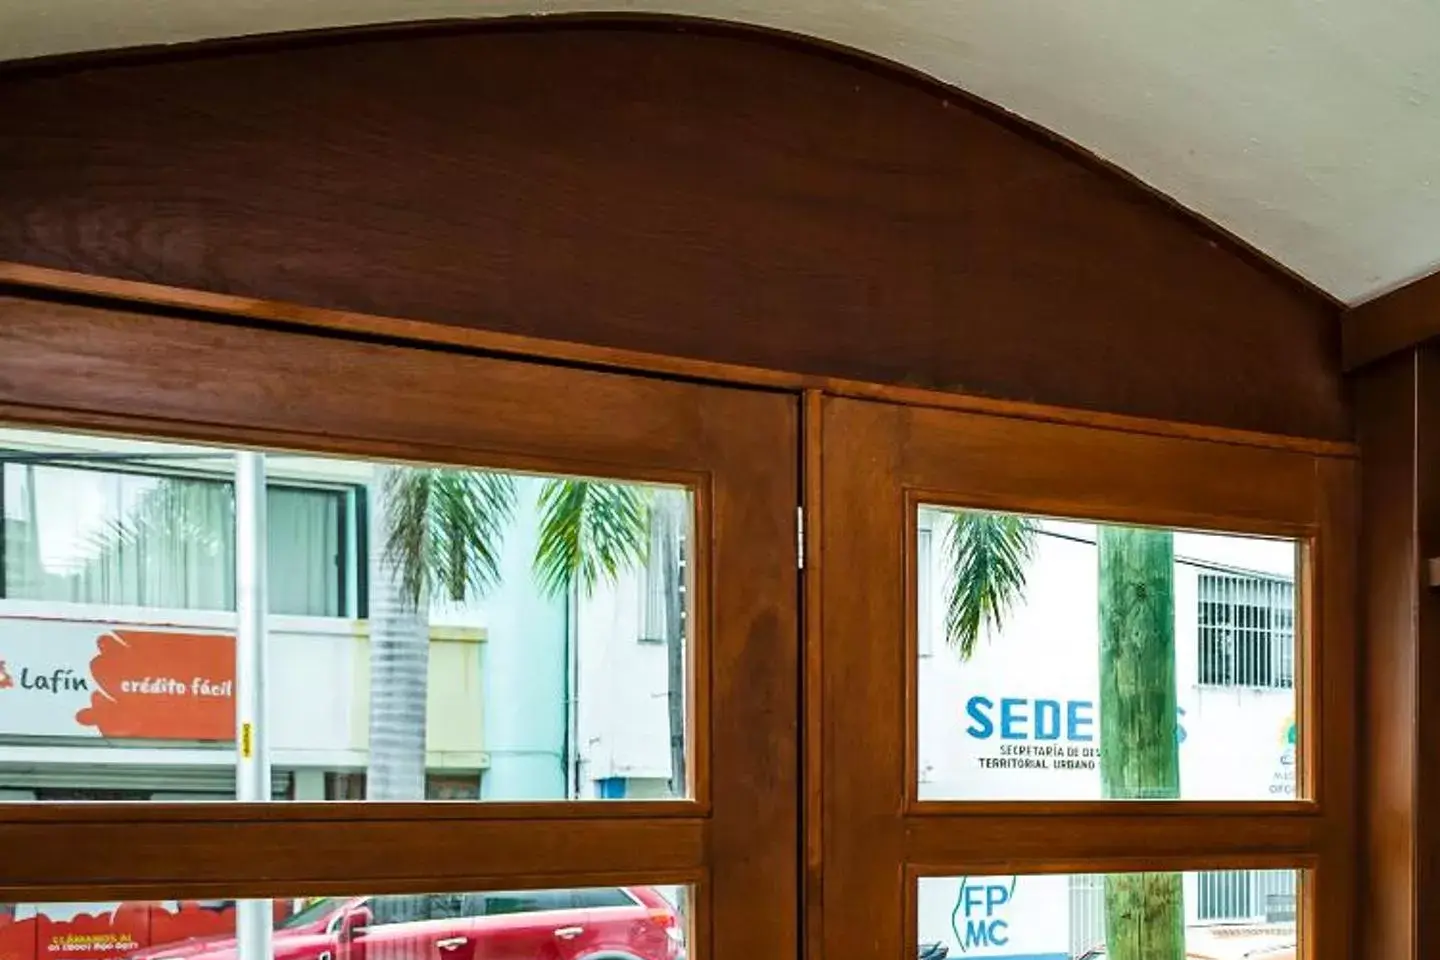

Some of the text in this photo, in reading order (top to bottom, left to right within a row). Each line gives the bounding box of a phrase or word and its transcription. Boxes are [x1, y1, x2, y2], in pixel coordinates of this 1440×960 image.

[20, 667, 88, 694] Lafín
[121, 677, 233, 697] crédito fácil
[1000, 743, 1064, 757] SECRETARÍA
[978, 757, 1096, 770] TERRITORIAL URBANO
[965, 885, 1008, 917] FP
[965, 919, 1008, 948] MC
